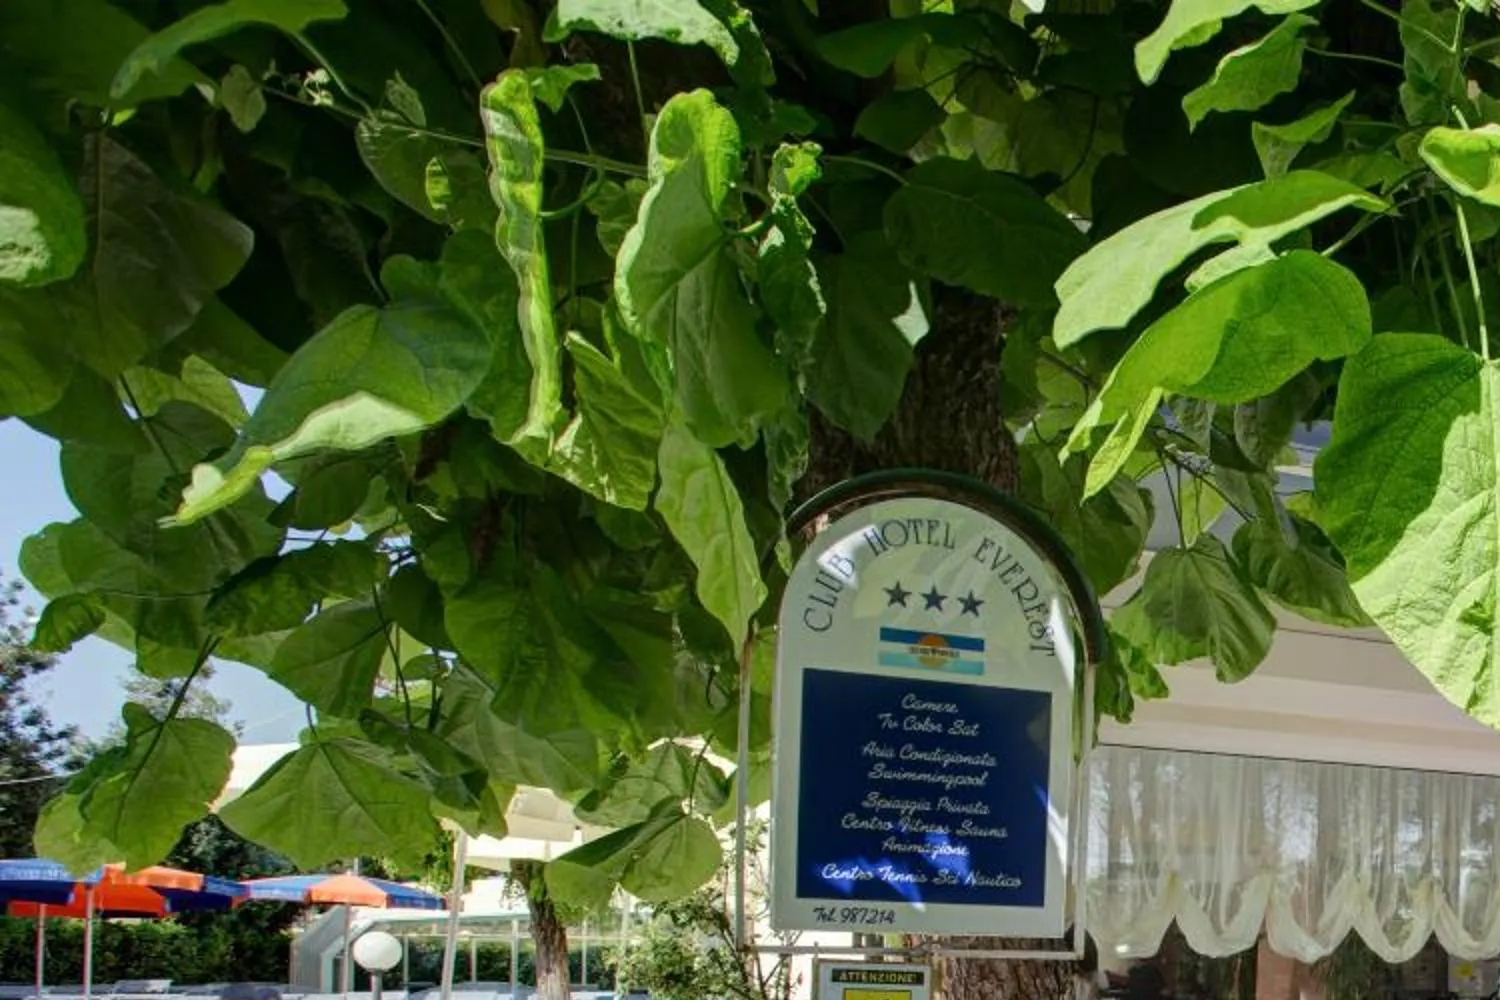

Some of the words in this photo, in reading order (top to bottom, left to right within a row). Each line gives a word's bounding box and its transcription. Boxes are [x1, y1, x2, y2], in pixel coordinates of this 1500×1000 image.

[803, 553, 855, 632] CLUB
[863, 518, 956, 556] HOTEL
[973, 537, 1056, 657] EVEREST
[901, 693, 959, 713] Camere
[903, 715, 943, 733] Color
[947, 719, 980, 736] Sat
[862, 740, 896, 758] Aria
[861, 791, 932, 816] Spiaggia
[936, 797, 991, 815] Privata
[841, 812, 894, 831] Centro
[955, 819, 1008, 838] Sauna
[882, 835, 970, 860] Animazione
[821, 863, 875, 880] Centro
[878, 864, 928, 884] Tennis
[932, 867, 960, 885] Sci
[964, 870, 1022, 888] Nautico
